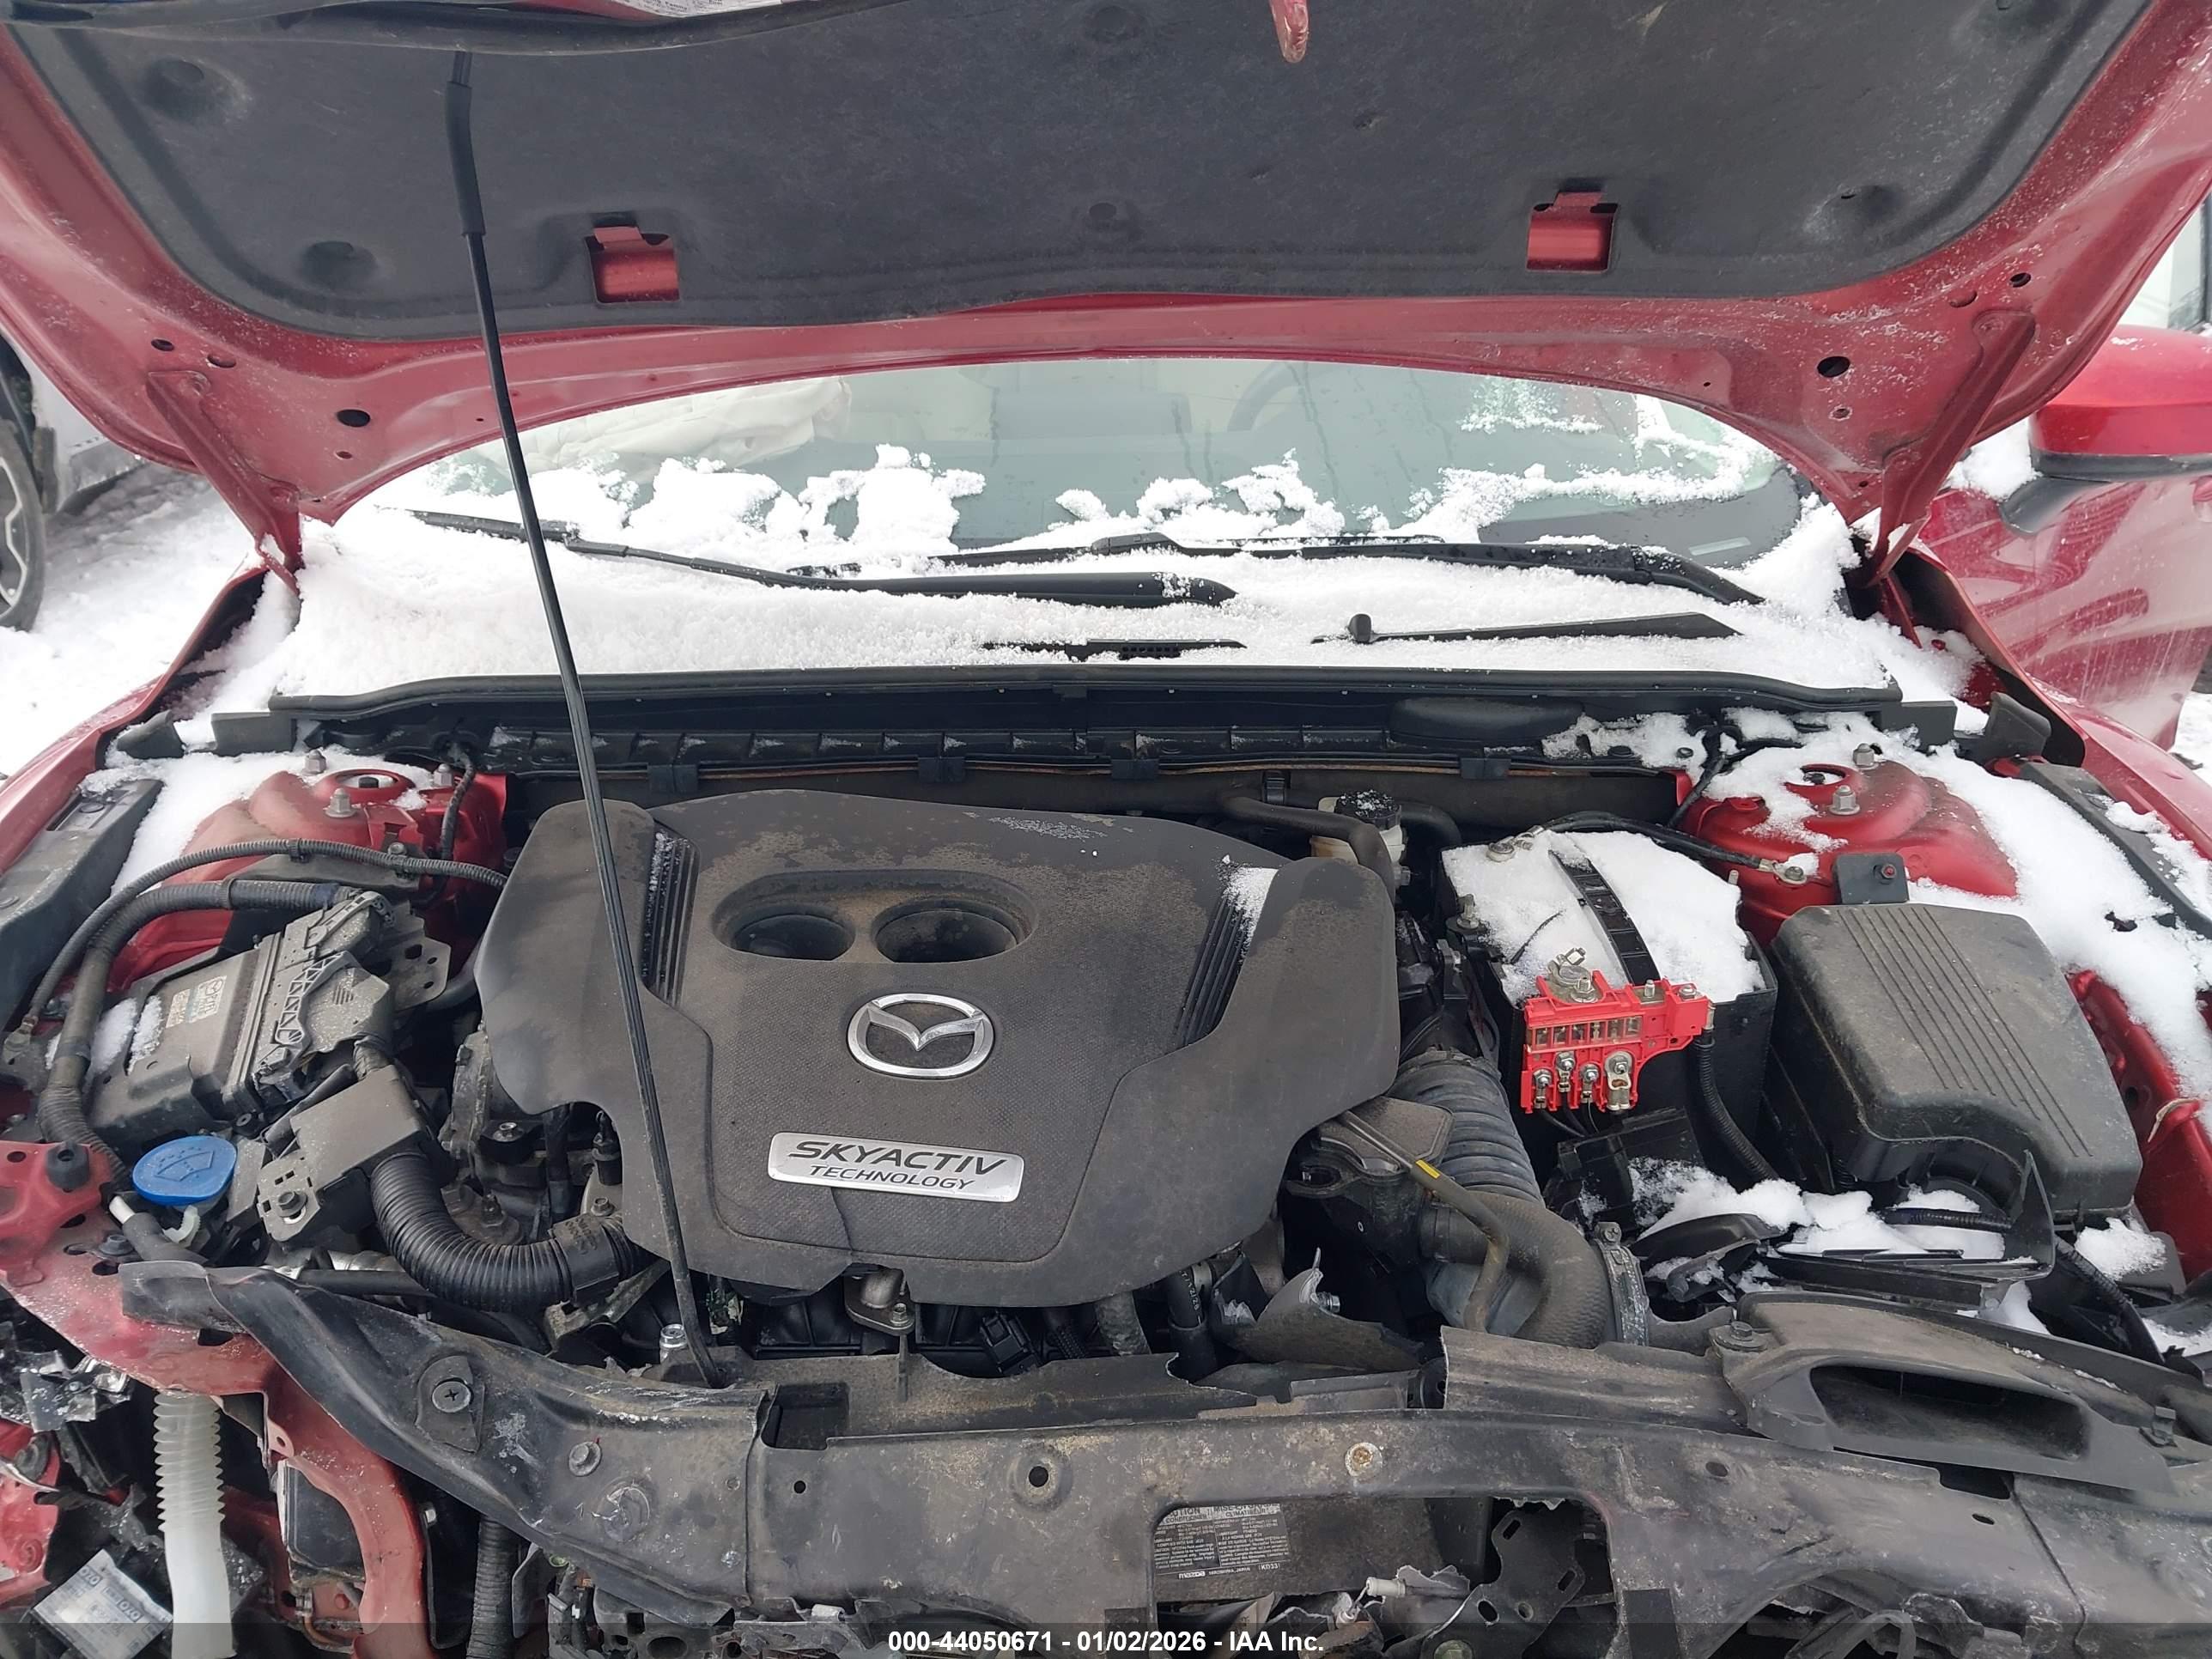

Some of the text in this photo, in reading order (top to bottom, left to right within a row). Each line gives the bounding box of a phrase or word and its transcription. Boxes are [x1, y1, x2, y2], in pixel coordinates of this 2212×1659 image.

[788, 1141, 1006, 1175] SKYACTIV
[810, 1165, 975, 1190] TECHNOLOGY
[1178, 1571, 1206, 1579] mazda
